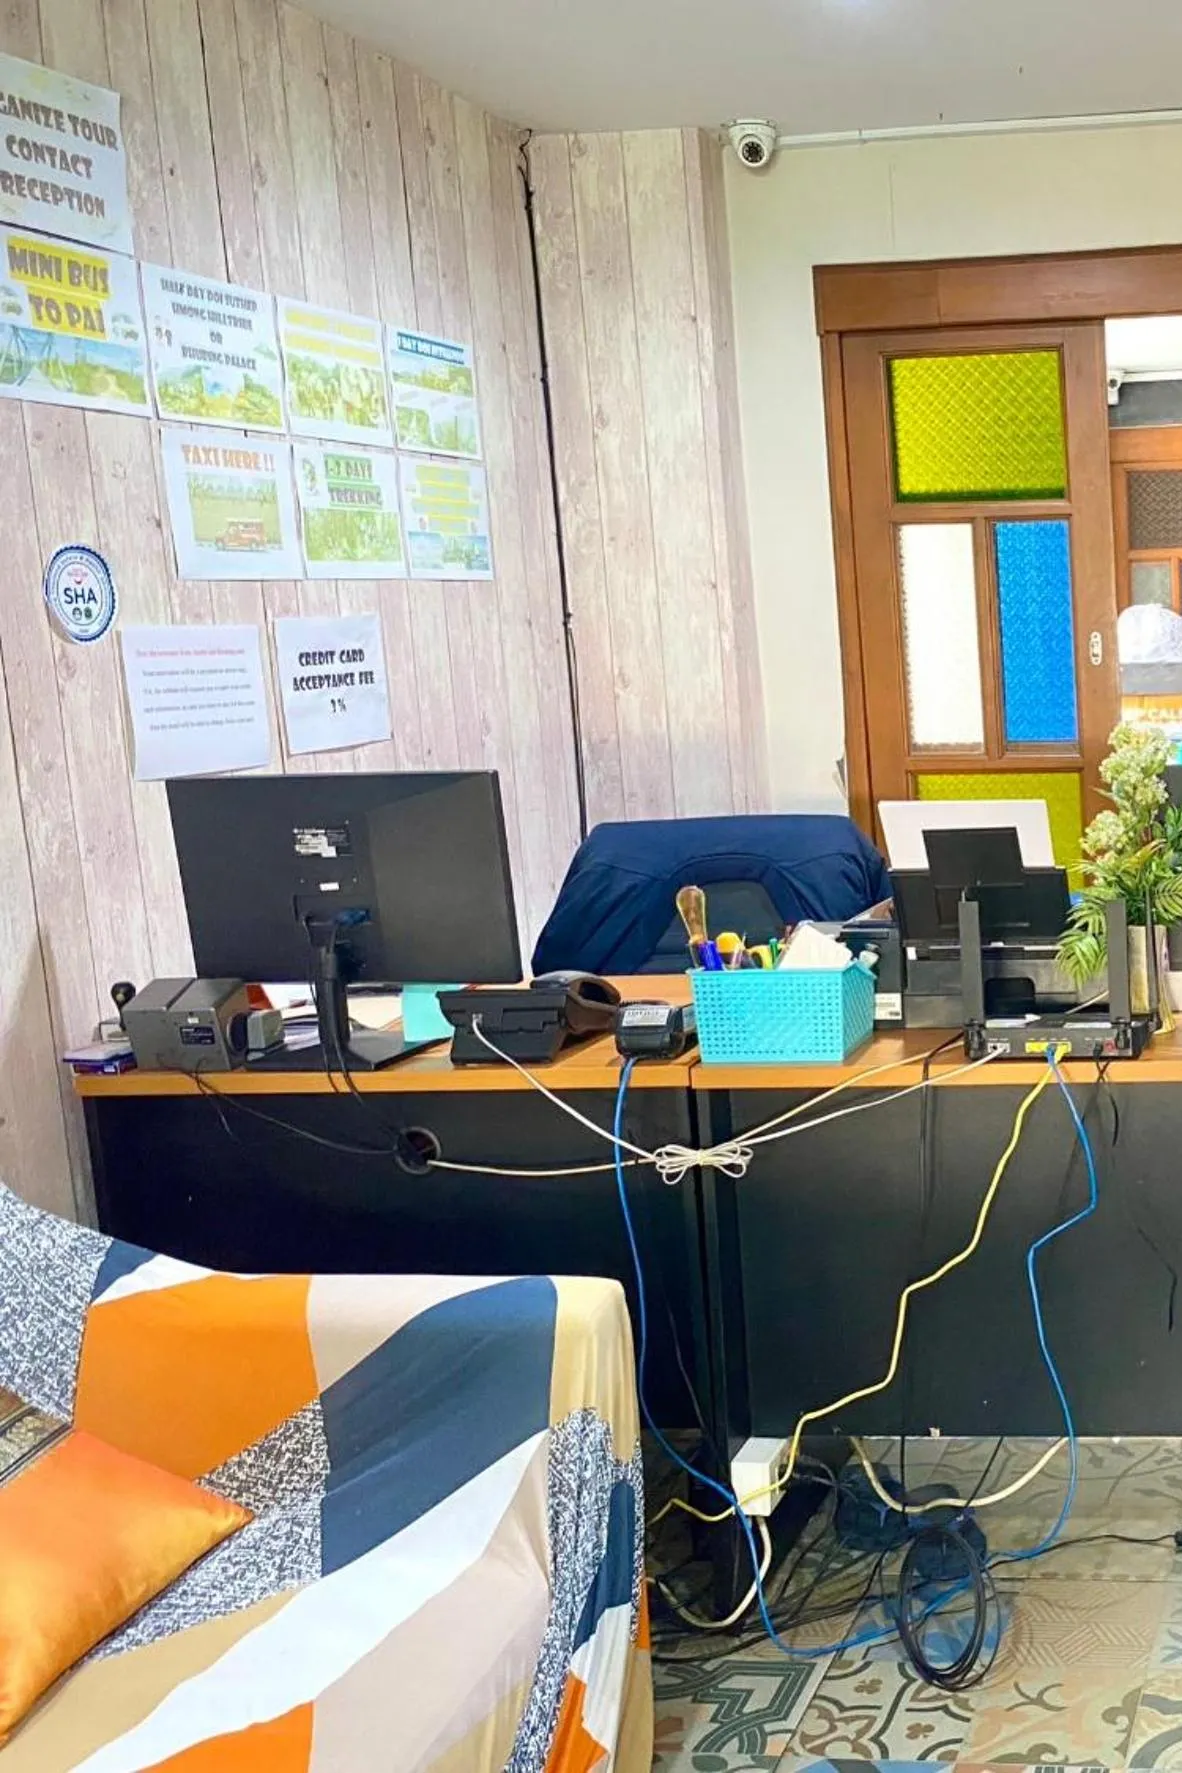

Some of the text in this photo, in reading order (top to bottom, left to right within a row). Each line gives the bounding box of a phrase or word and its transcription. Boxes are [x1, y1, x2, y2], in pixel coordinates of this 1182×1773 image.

[67, 113, 118, 151] YOUR
[6, 134, 93, 179] CONTACT
[0, 170, 105, 218] RECEPTION
[8, 245, 109, 294] MINI BUS
[28, 293, 106, 333] TO PAI
[181, 443, 220, 468] TAXI
[63, 587, 98, 605] SHA
[298, 648, 365, 667] CREDIT CARD
[293, 670, 375, 692] ACCEPTANCE FEE
